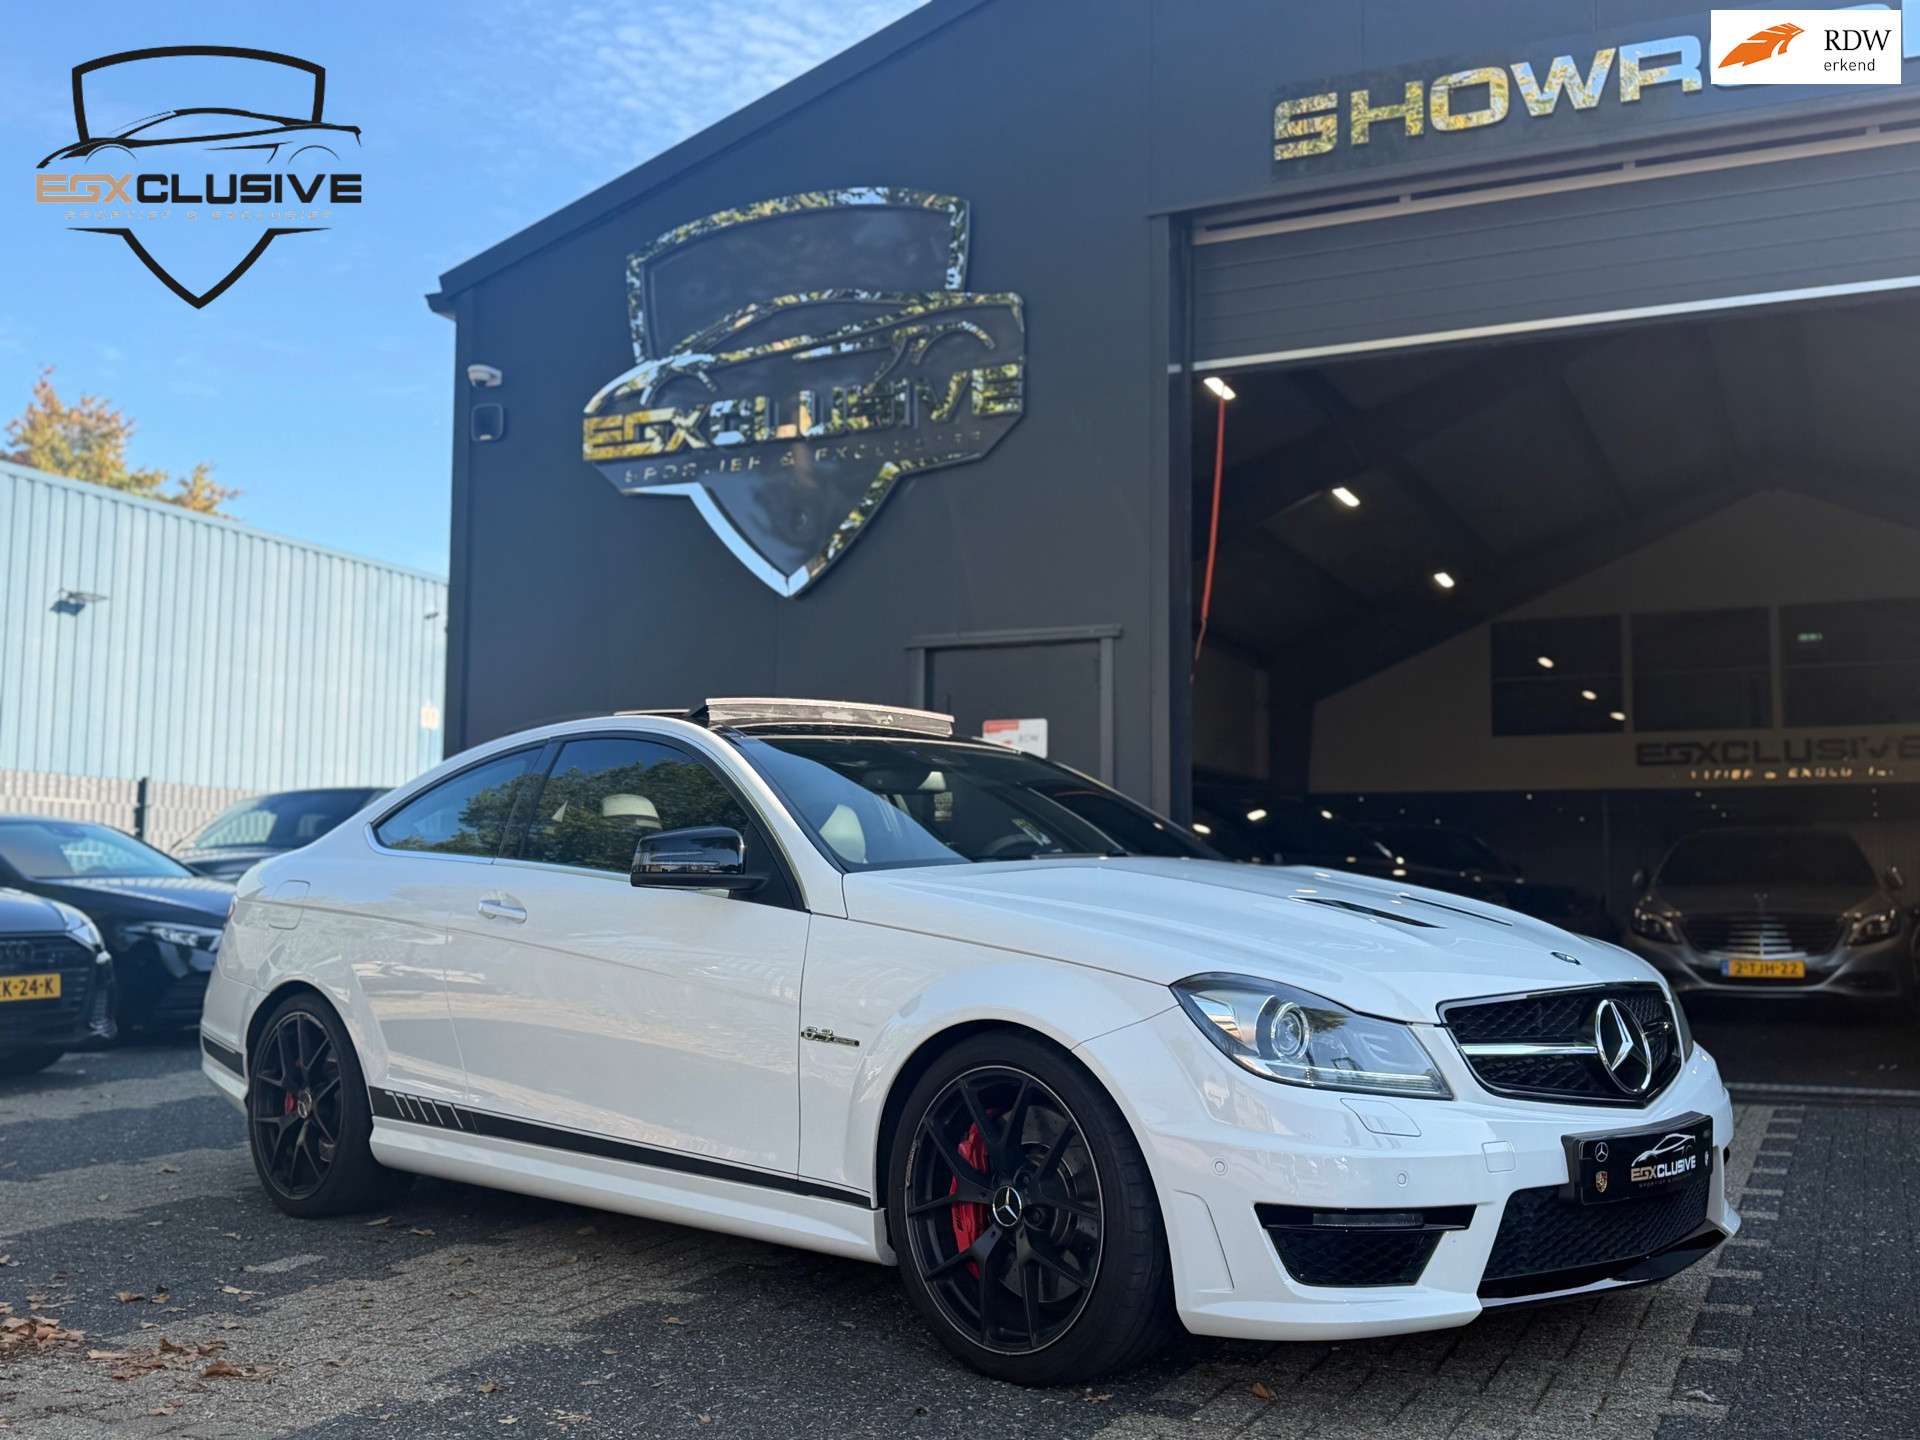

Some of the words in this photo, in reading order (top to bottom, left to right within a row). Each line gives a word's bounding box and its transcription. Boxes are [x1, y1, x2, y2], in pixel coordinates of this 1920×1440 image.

[582, 362, 1023, 462] EGXCLUSIVE
[0, 977, 55, 998] K-24-K
[1630, 1155, 1696, 1182] EGXCLUSIVE
